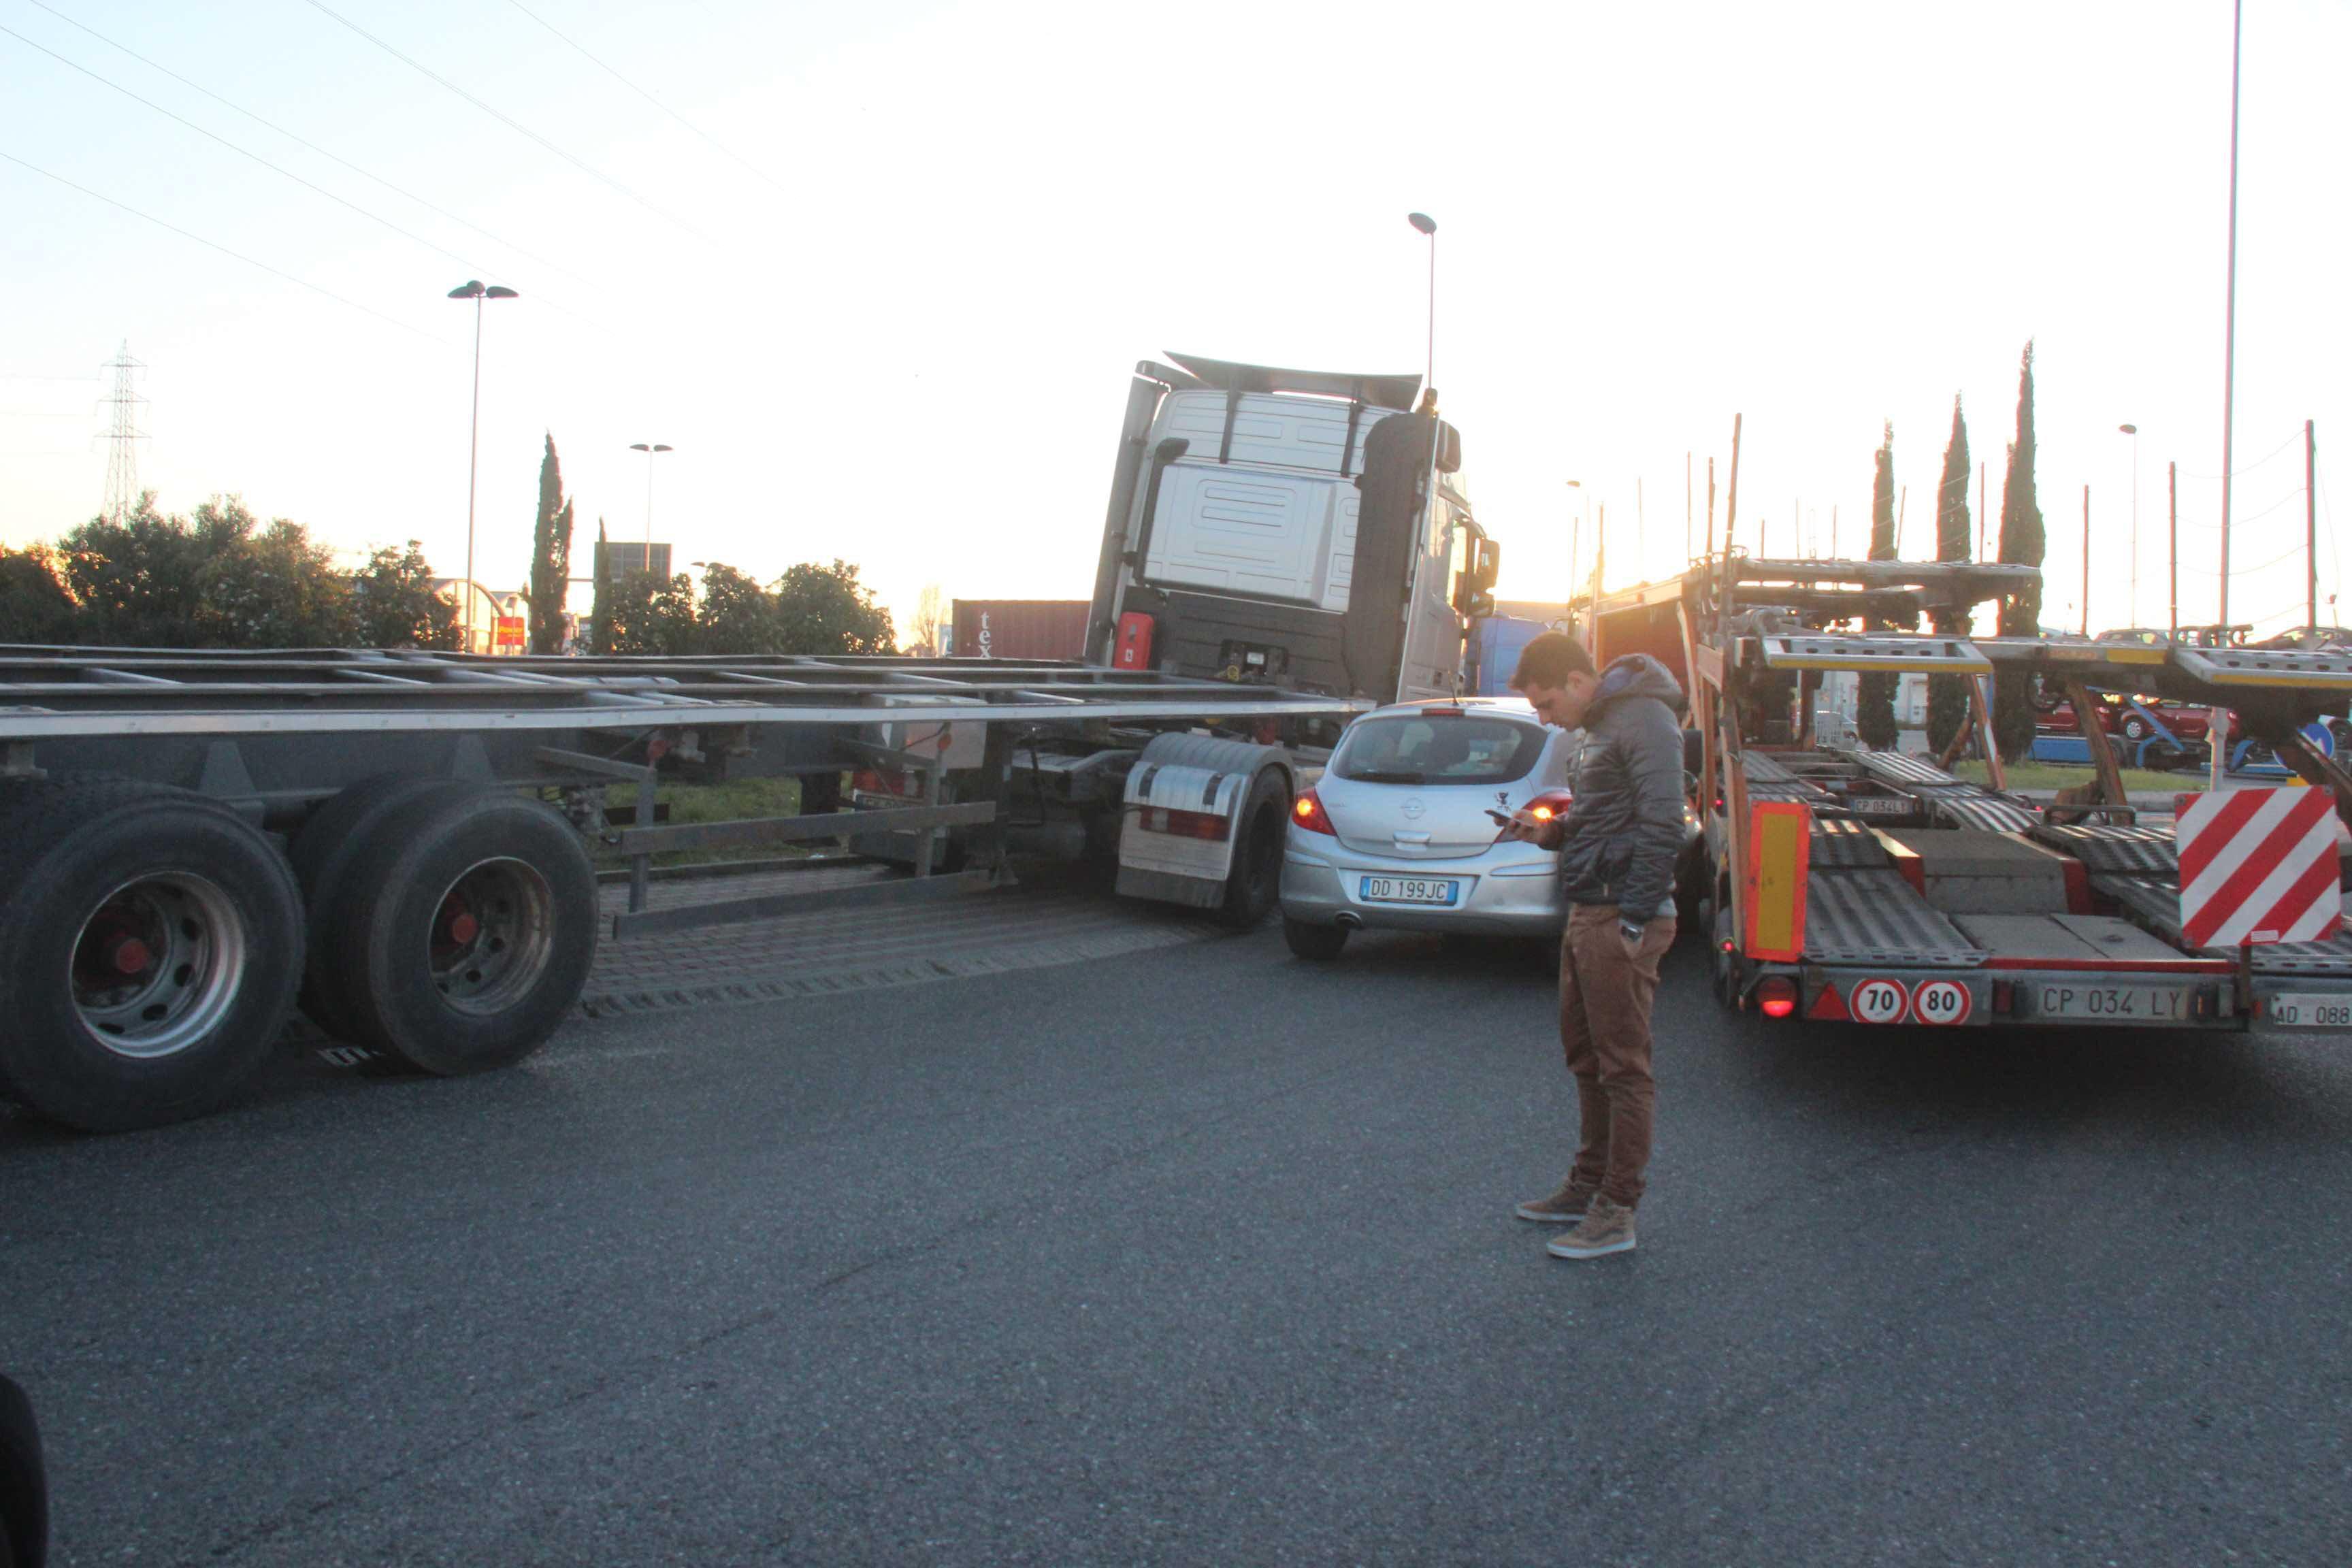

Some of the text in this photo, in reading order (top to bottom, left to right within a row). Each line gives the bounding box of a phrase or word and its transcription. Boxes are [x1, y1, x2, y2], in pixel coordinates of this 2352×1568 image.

[1371, 879, 1446, 900] DD 199JC
[1867, 989, 1894, 1011] 70
[1927, 990, 1955, 1012] 80
[2044, 987, 2180, 1016] CP 034 LY
